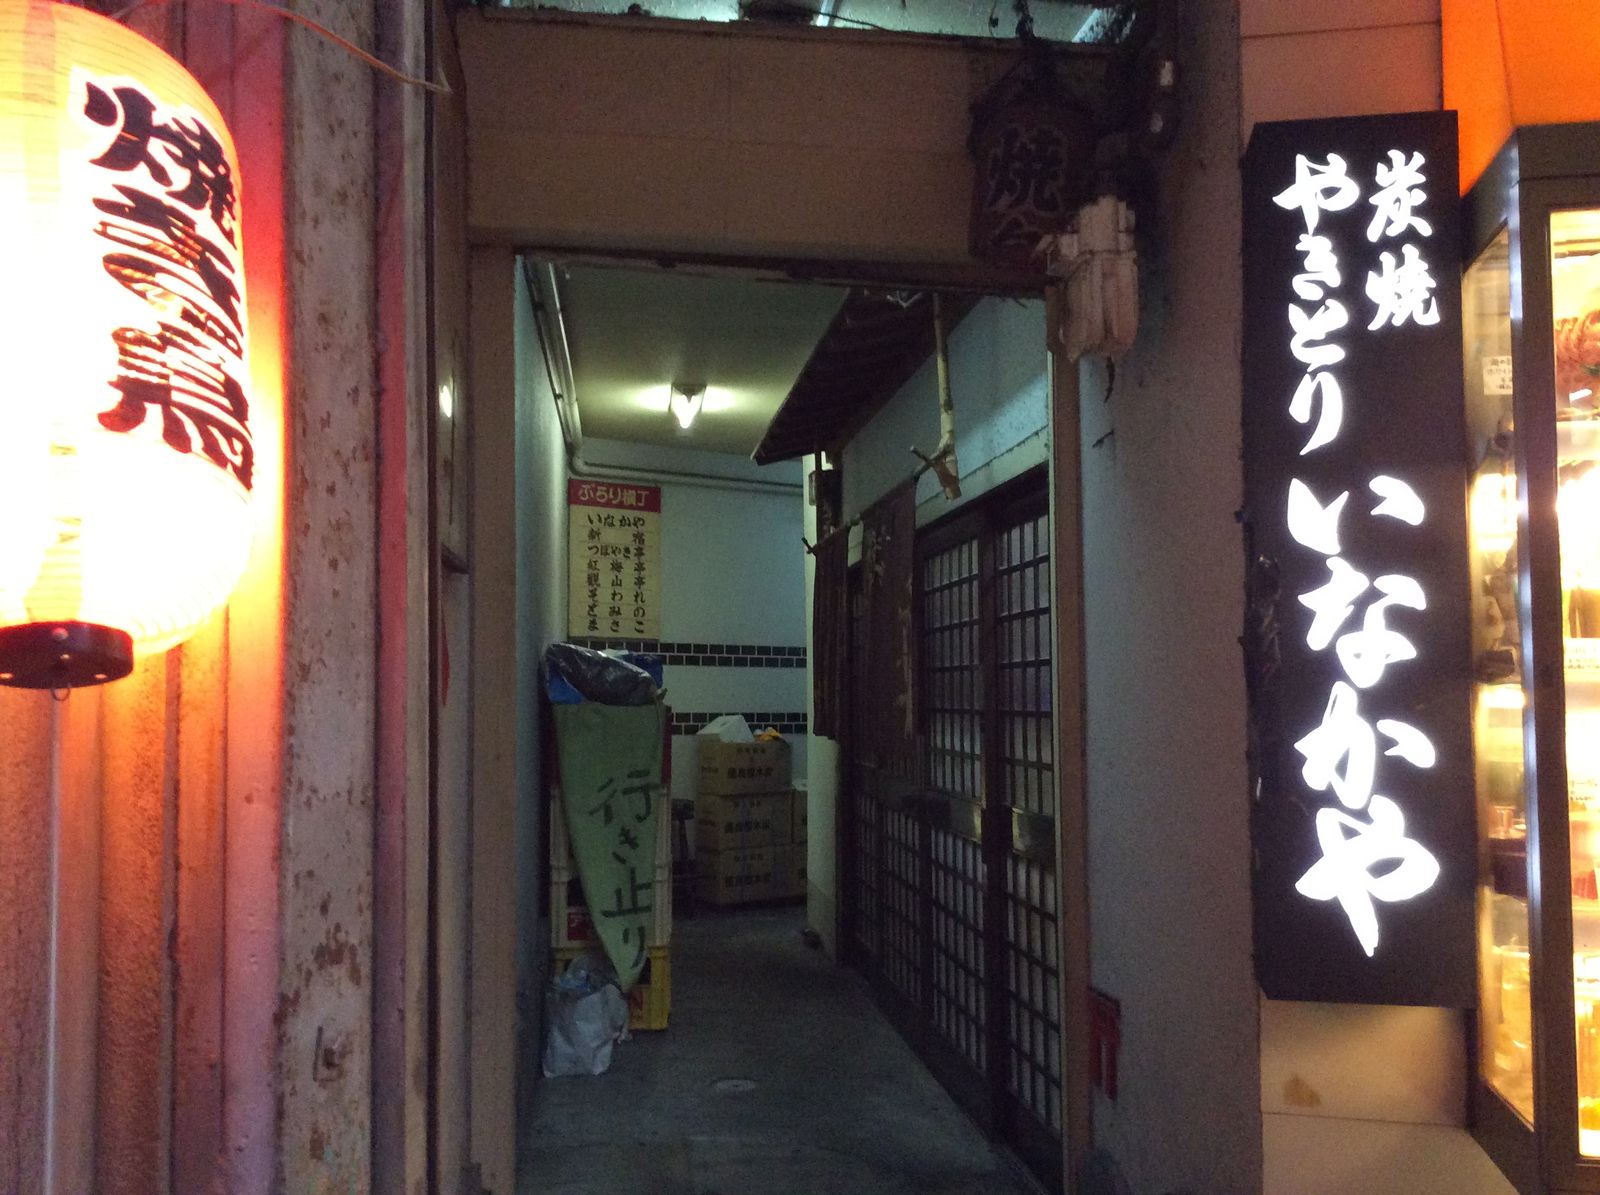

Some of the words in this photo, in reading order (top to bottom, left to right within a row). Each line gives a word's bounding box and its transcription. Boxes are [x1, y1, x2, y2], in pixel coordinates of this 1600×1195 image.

[1272, 152, 1360, 456] やきとり
[1366, 149, 1441, 331] 炭焼
[579, 484, 649, 506] ぶらり横丁
[587, 514, 645, 528] いなかや
[1287, 475, 1441, 957] いなかや
[588, 769, 659, 969] 行き止り
